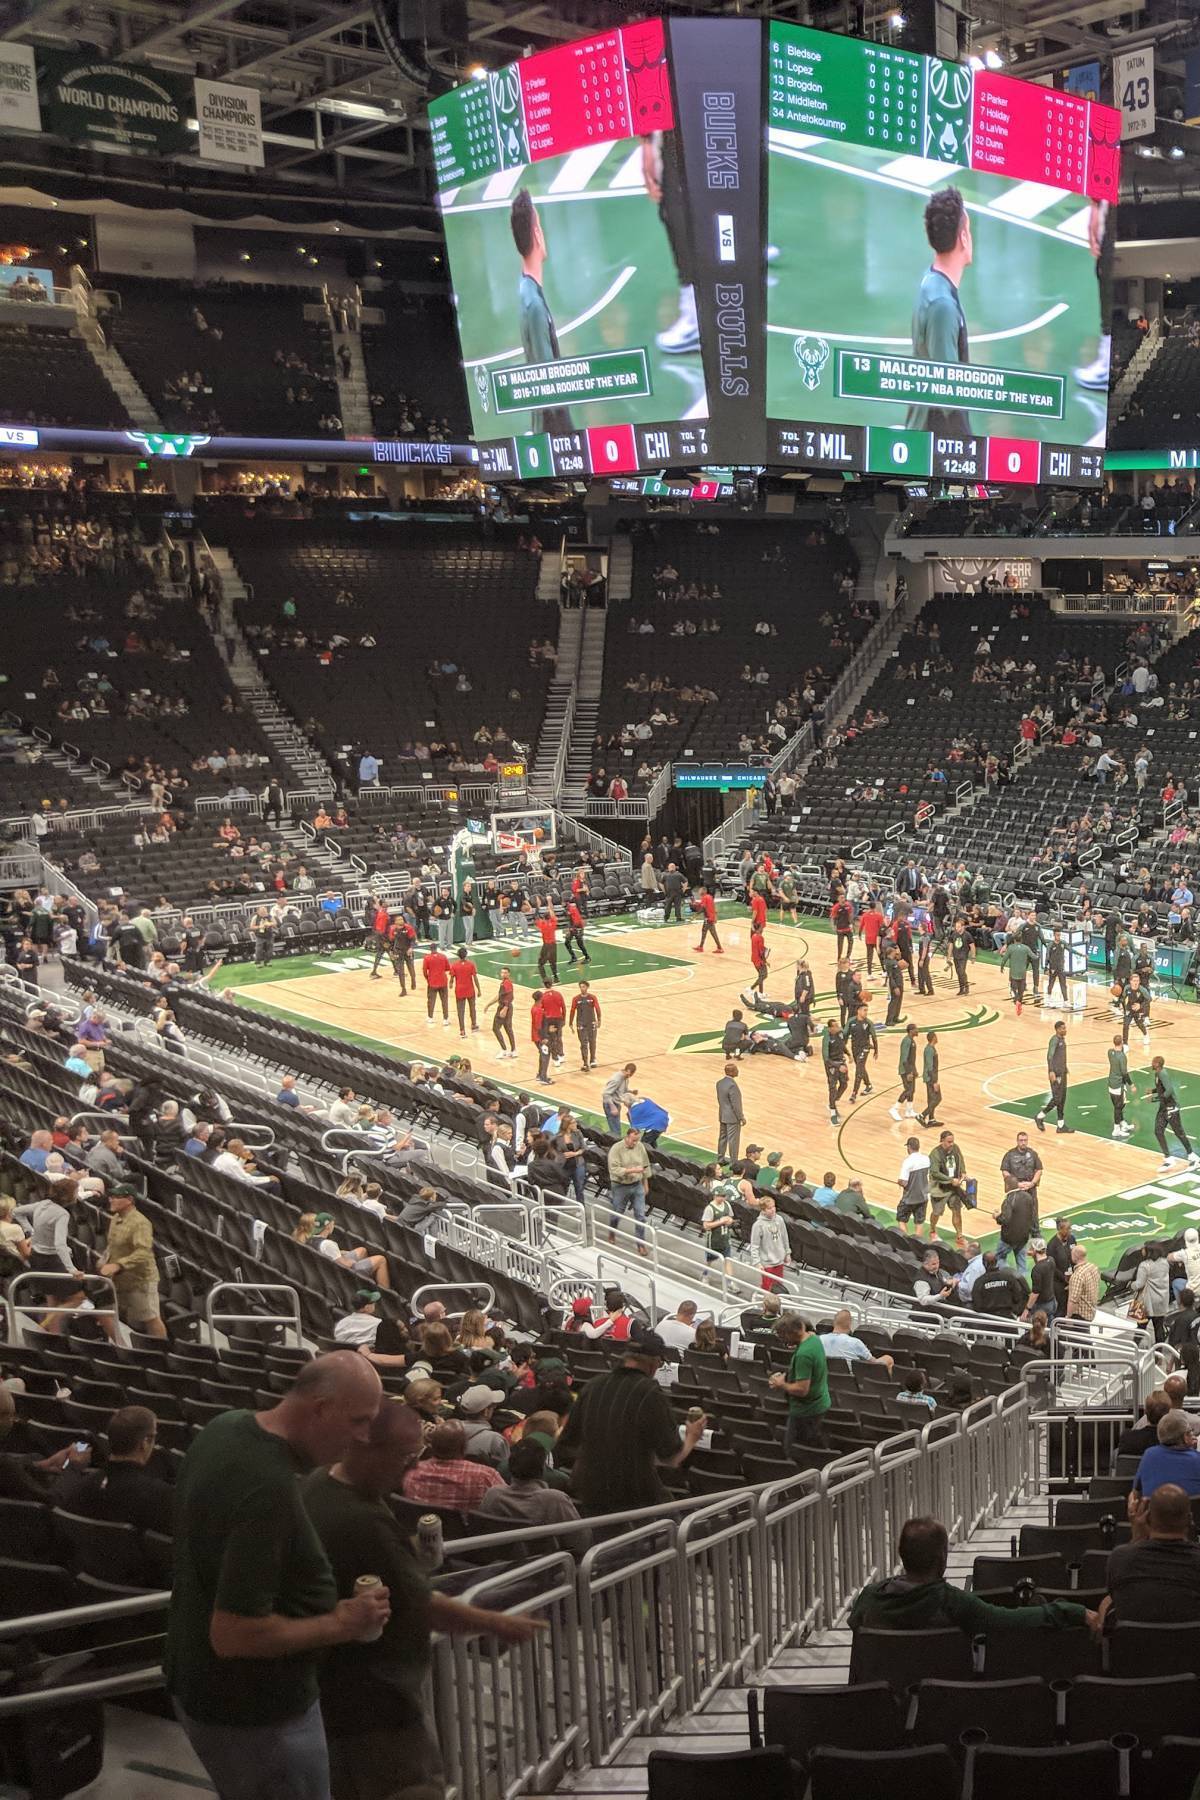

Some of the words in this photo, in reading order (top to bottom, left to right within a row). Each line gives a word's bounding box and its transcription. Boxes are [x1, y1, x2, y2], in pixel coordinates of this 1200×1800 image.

[774, 43, 779, 52] 6
[787, 45, 821, 61] Bledsoe
[774, 59, 782, 68] 11
[787, 61, 813, 75] Lopez
[1126, 57, 1147, 71] TATUM
[774, 75, 784, 85] 13
[787, 77, 822, 93] Brogdon
[57, 84, 105, 111] WORLD
[107, 94, 179, 123] CHAMPIONS
[208, 92, 248, 112] DIVISION
[773, 91, 784, 101] 22
[787, 94, 827, 111] Middleton
[981, 93, 985, 102] 2
[987, 94, 1008, 107] Parker
[1122, 77, 1150, 113] 43
[202, 105, 256, 127] CHAMPIONS
[772, 107, 784, 118] 34
[981, 106, 985, 115] 7
[986, 108, 1010, 123] Holiday
[980, 121, 984, 129] 8
[986, 121, 1008, 136] LaVine
[538, 137, 554, 149] Lopez
[703, 91, 739, 189] BUCKS
[975, 135, 984, 145] 32
[986, 136, 1003, 150] Dunn
[975, 150, 984, 160] 42
[986, 151, 1005, 165] Lopez
[721, 228, 732, 247] VS
[716, 283, 749, 396] BULLS
[499, 375, 507, 387] 13
[511, 367, 547, 385] MALCOLM
[549, 362, 590, 380] BROGDON
[853, 358, 870, 372] 13
[879, 361, 944, 380] MALCOLM
[947, 368, 1004, 386] BROGDON
[513, 387, 540, 399] 2016-17
[541, 383, 556, 396] NBA
[557, 381, 584, 394] ROOKIE
[585, 379, 595, 390] OF
[597, 377, 613, 388] THE
[614, 373, 638, 386] YEAR
[880, 378, 928, 393] 2016-17
[931, 383, 953, 396] NBA
[956, 387, 994, 401] ROOKIE
[995, 390, 1008, 402] OF
[1010, 392, 1028, 405] THE
[1029, 395, 1053, 407] YEAR
[6, 430, 25, 441] VS
[699, 429, 705, 440] 7
[782, 431, 800, 441] TOL
[806, 432, 815, 444] 7
[553, 437, 571, 453] QTR
[574, 435, 581, 450] 1
[606, 440, 618, 462] 0
[645, 431, 670, 459] CHI
[701, 443, 708, 454] 0
[806, 445, 814, 457] 0
[820, 432, 852, 461] MIL
[937, 439, 964, 455] QTR
[969, 441, 977, 456] 1
[496, 448, 512, 471] MIL
[529, 447, 539, 468] 0
[892, 442, 908, 464] 0
[1096, 456, 1101, 465] 7
[560, 456, 583, 471] 12:48
[943, 458, 976, 474] 12:48
[1007, 452, 1021, 473] 0
[1050, 452, 1071, 477] CHI
[653, 481, 660, 492] 0
[701, 484, 709, 494] 0
[721, 485, 733, 495] CHI
[1004, 562, 1032, 577] FEAR
[503, 765, 524, 776] 12:48
[984, 1280, 1009, 1290] SECURITY
